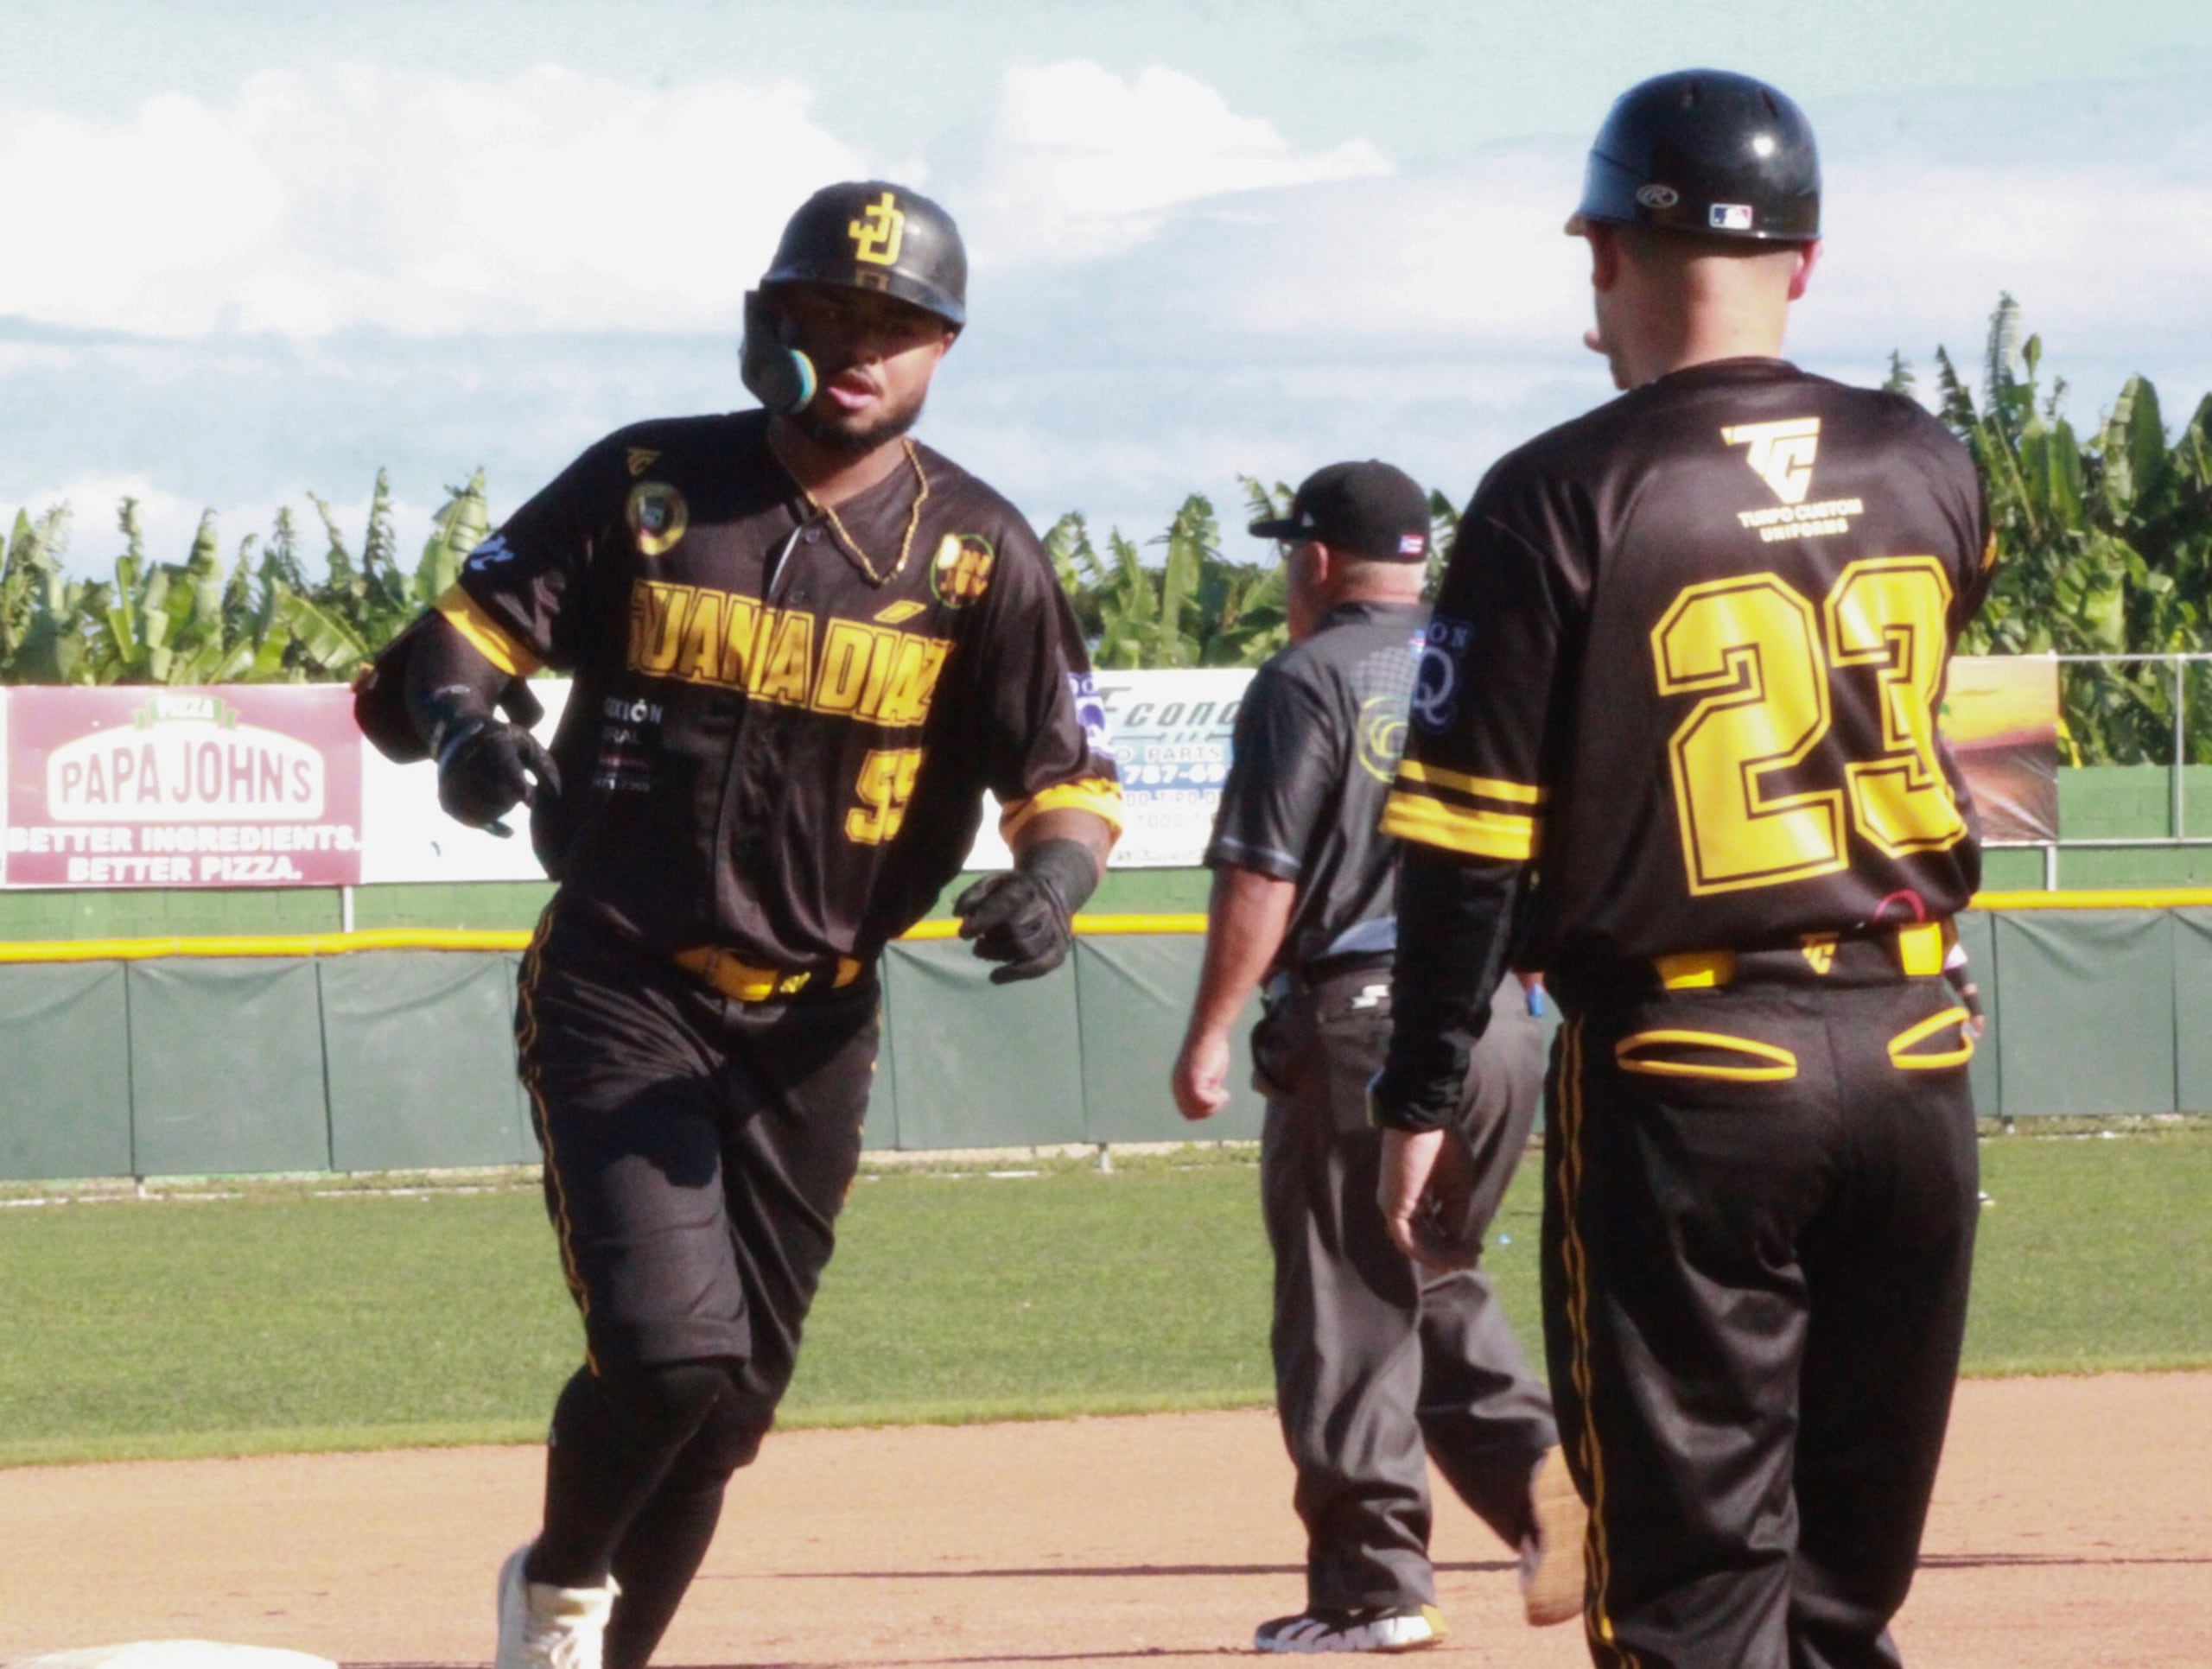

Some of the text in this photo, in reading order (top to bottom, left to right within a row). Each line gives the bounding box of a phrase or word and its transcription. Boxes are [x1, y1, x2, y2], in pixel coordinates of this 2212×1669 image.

[1650, 555, 1967, 896] 23
[1147, 746, 1221, 759] PARTS
[60, 743, 161, 804] PAPA
[6, 827, 132, 853] BETTER
[68, 856, 302, 881] BETTER PIZZA.
